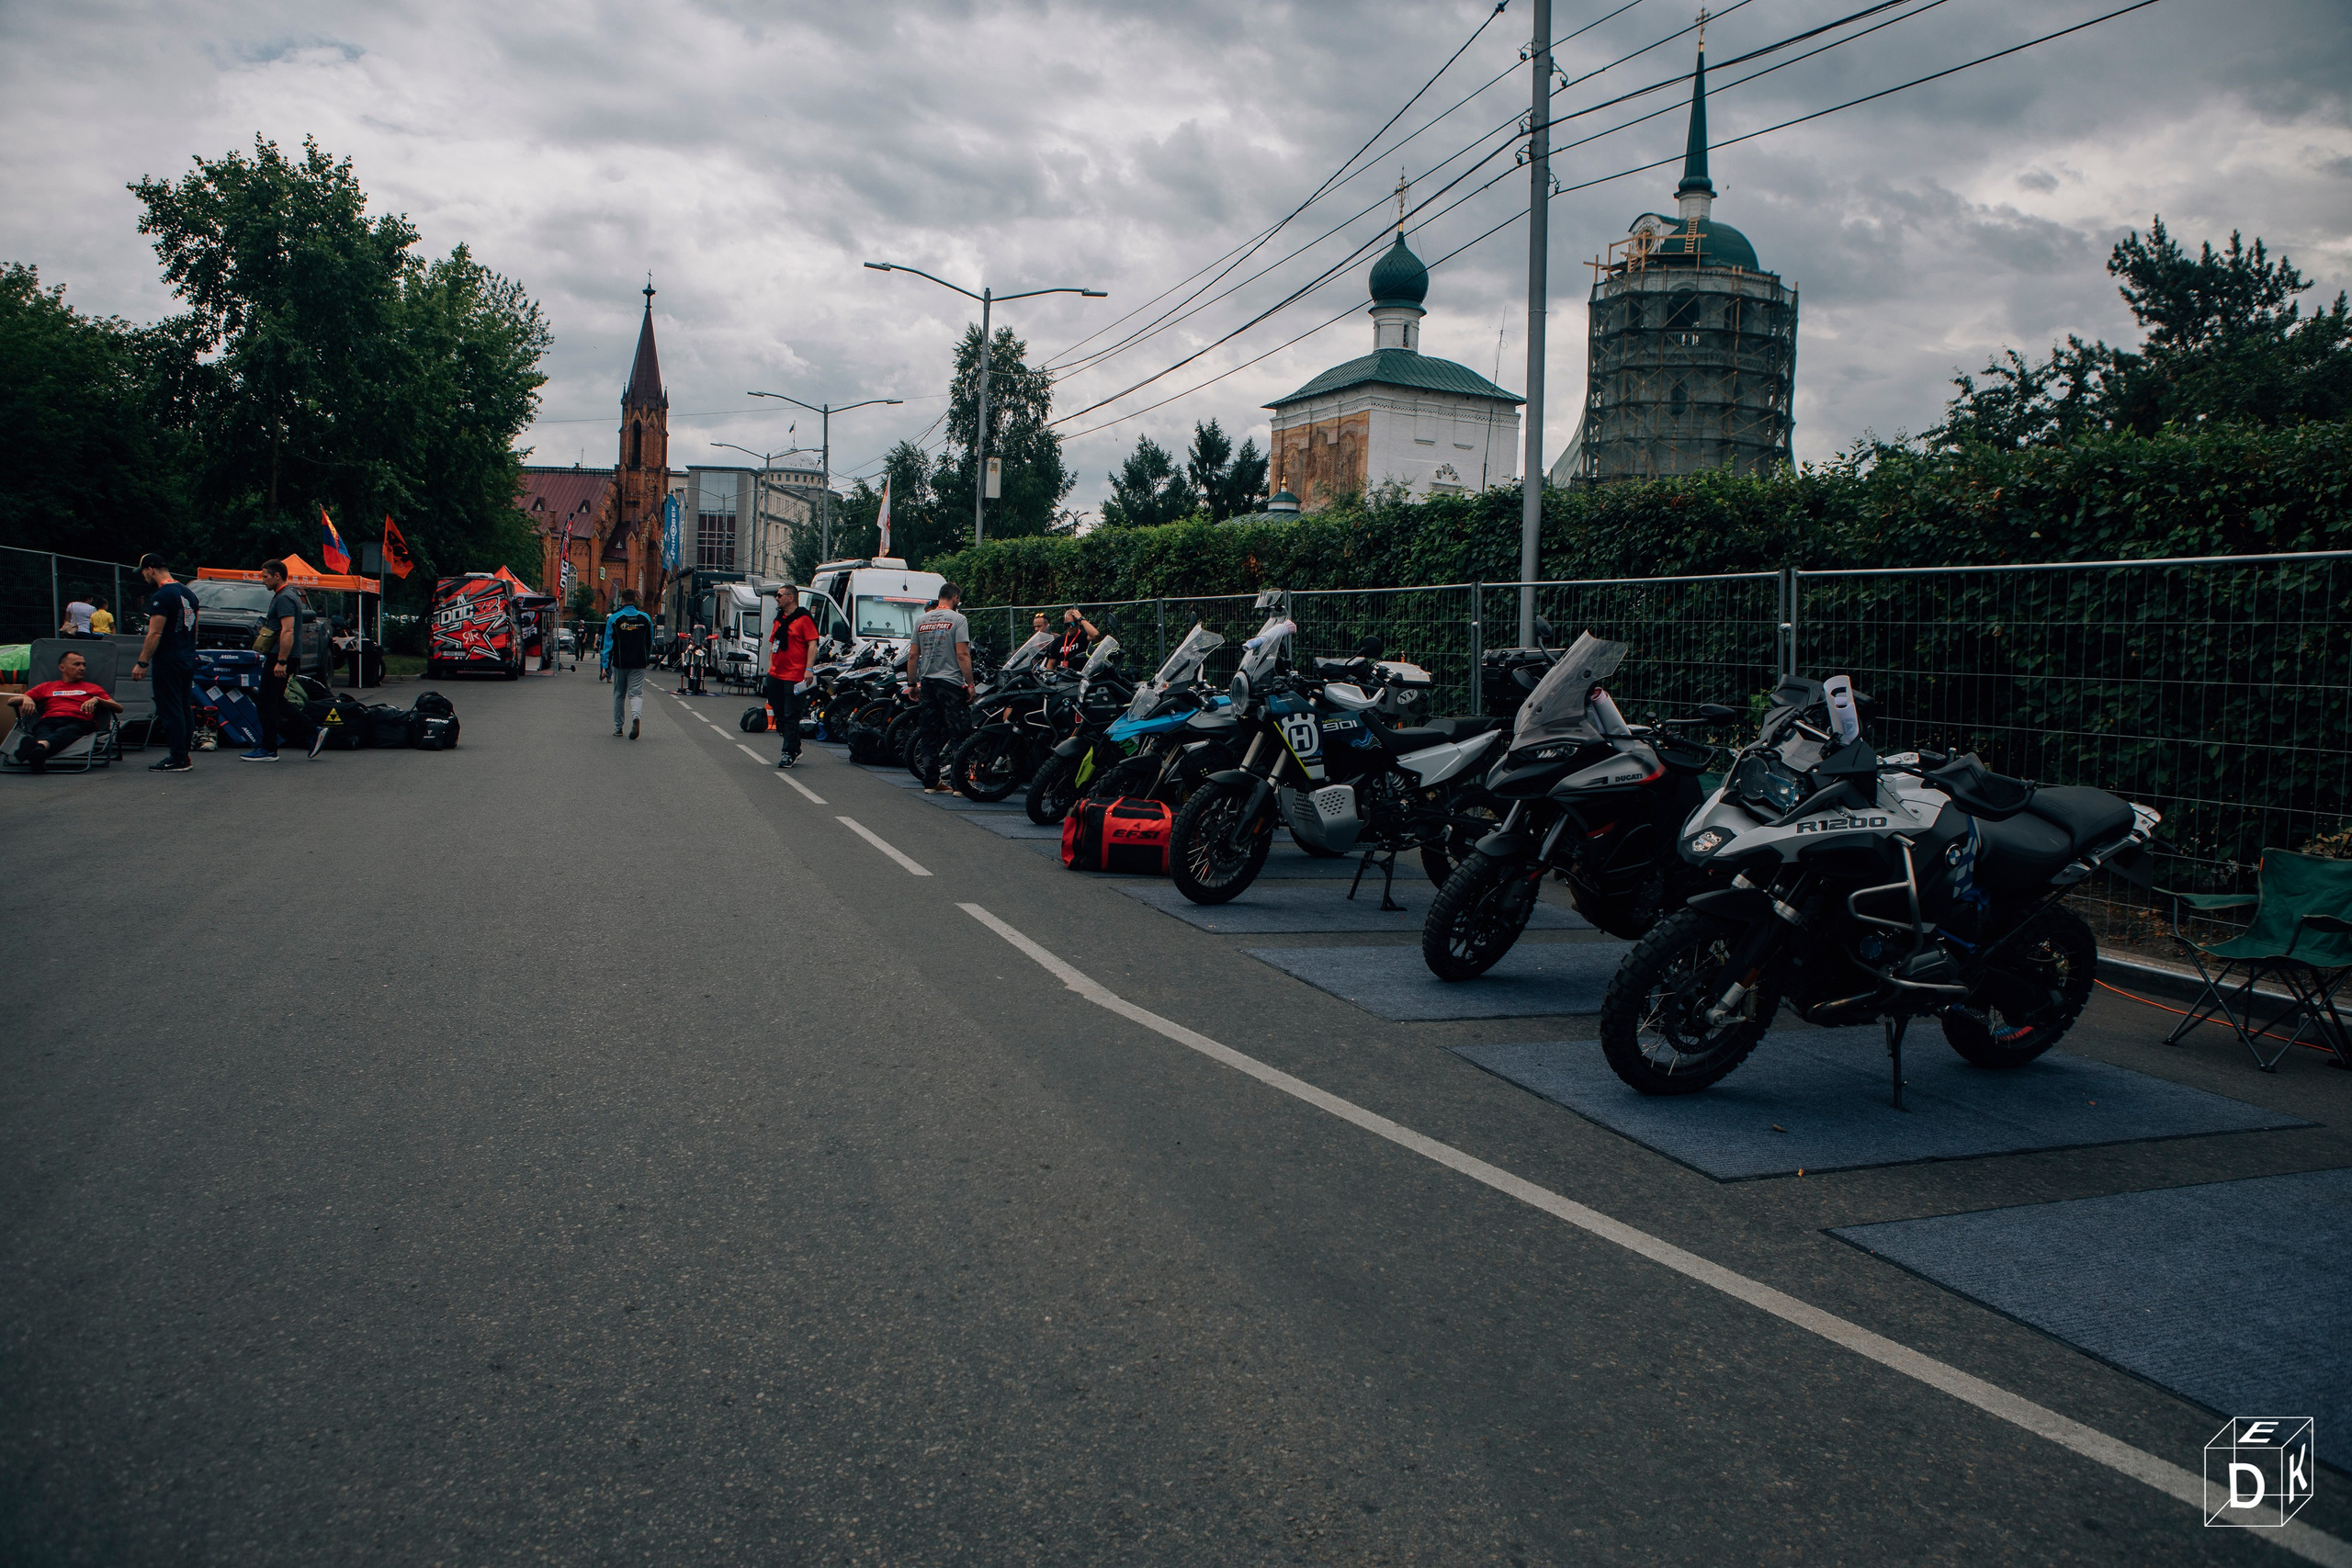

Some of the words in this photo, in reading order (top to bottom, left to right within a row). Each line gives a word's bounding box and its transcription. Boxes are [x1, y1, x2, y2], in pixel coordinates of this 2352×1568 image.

[440, 604, 474, 626] DOC
[474, 598, 498, 615] 32
[1399, 691, 1415, 703] NV
[1322, 719, 1358, 733] 901
[1615, 773, 1643, 783] DUCATI
[1796, 817, 1887, 834] R1200
[1112, 829, 1160, 840] EFSI
